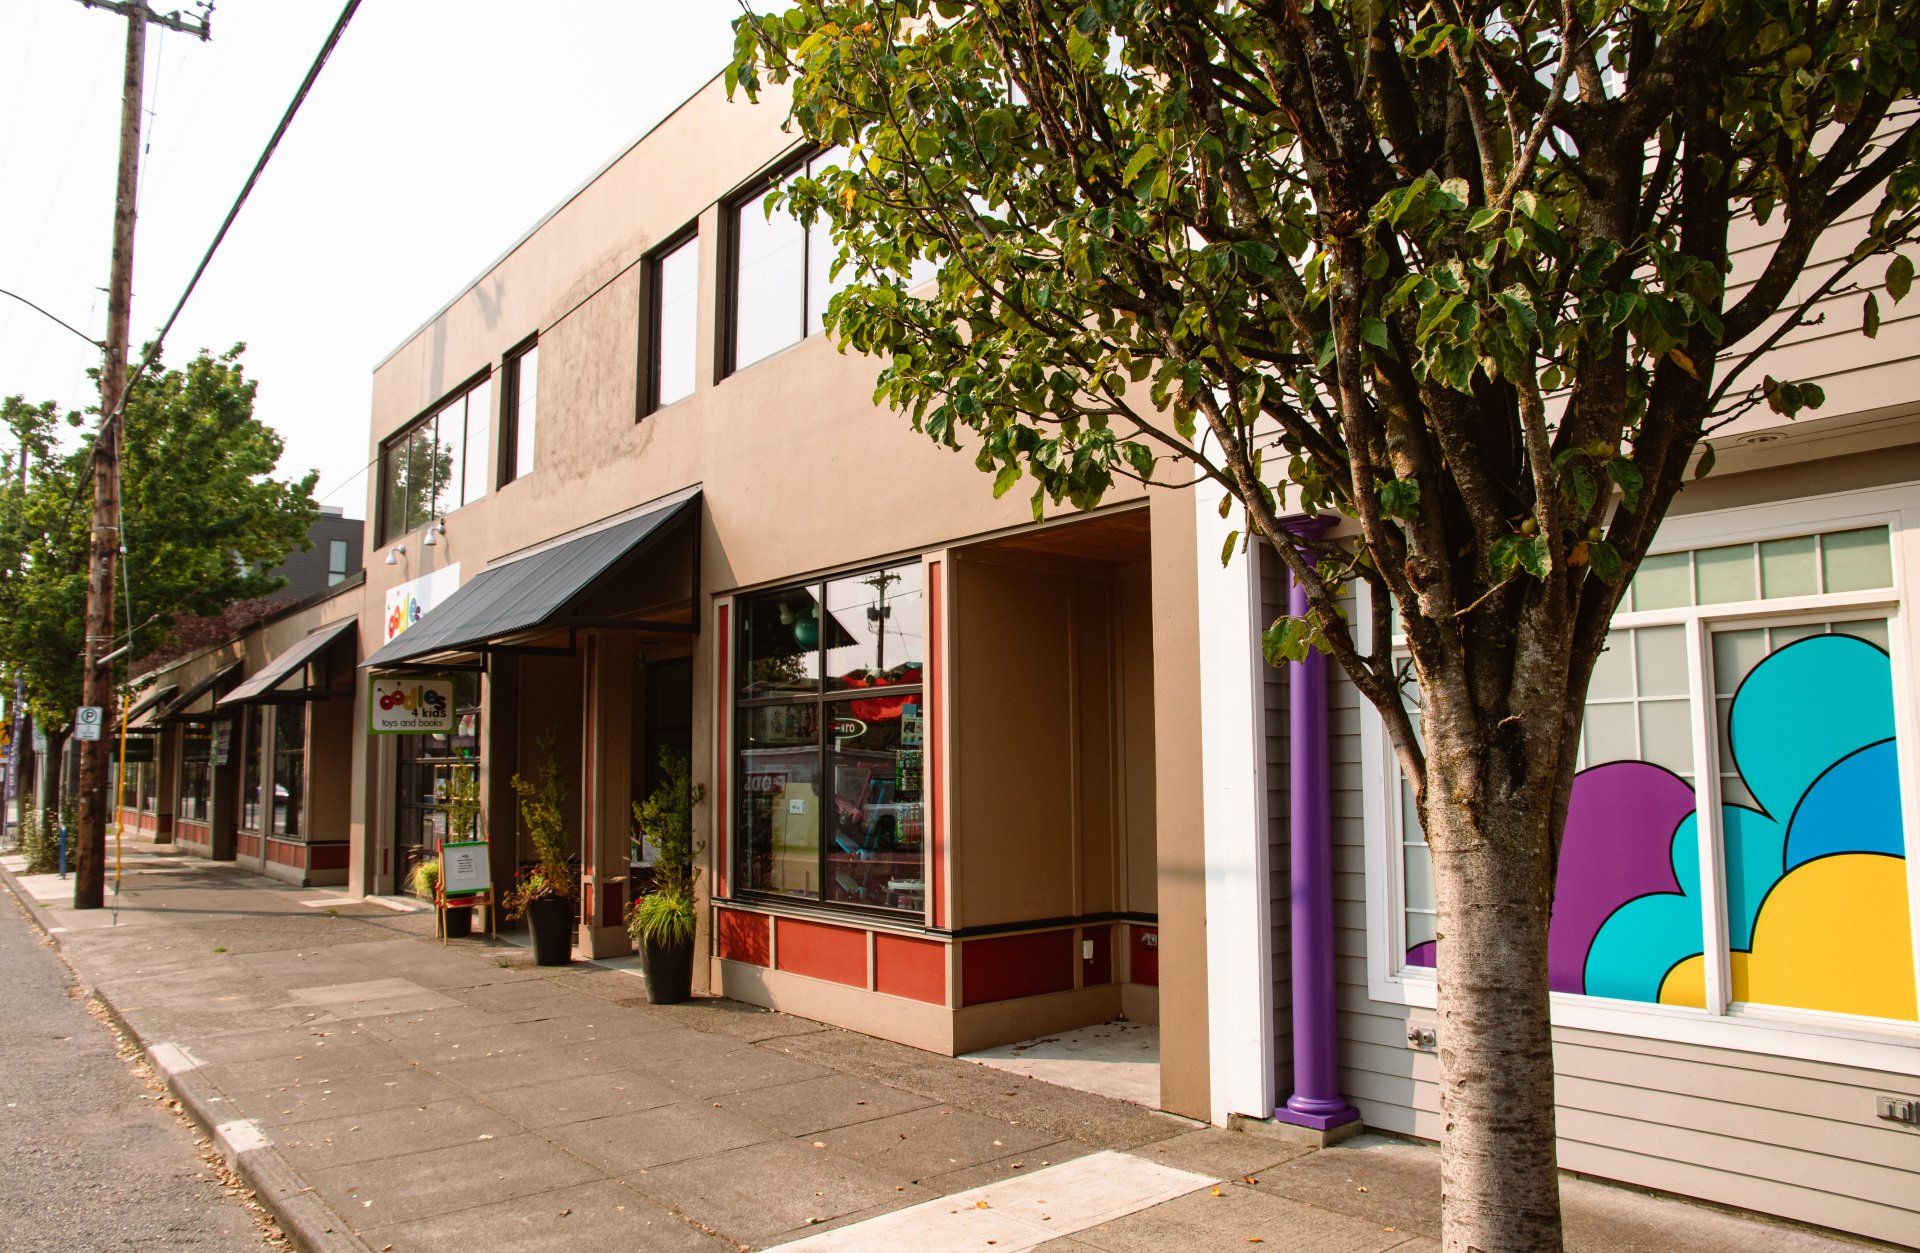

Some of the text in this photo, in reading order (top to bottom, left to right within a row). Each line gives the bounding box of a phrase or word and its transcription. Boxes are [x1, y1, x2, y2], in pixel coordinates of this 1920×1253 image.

[380, 685, 446, 710] oodles
[411, 708, 446, 718] 4 kids
[382, 719, 443, 728] toys and books
